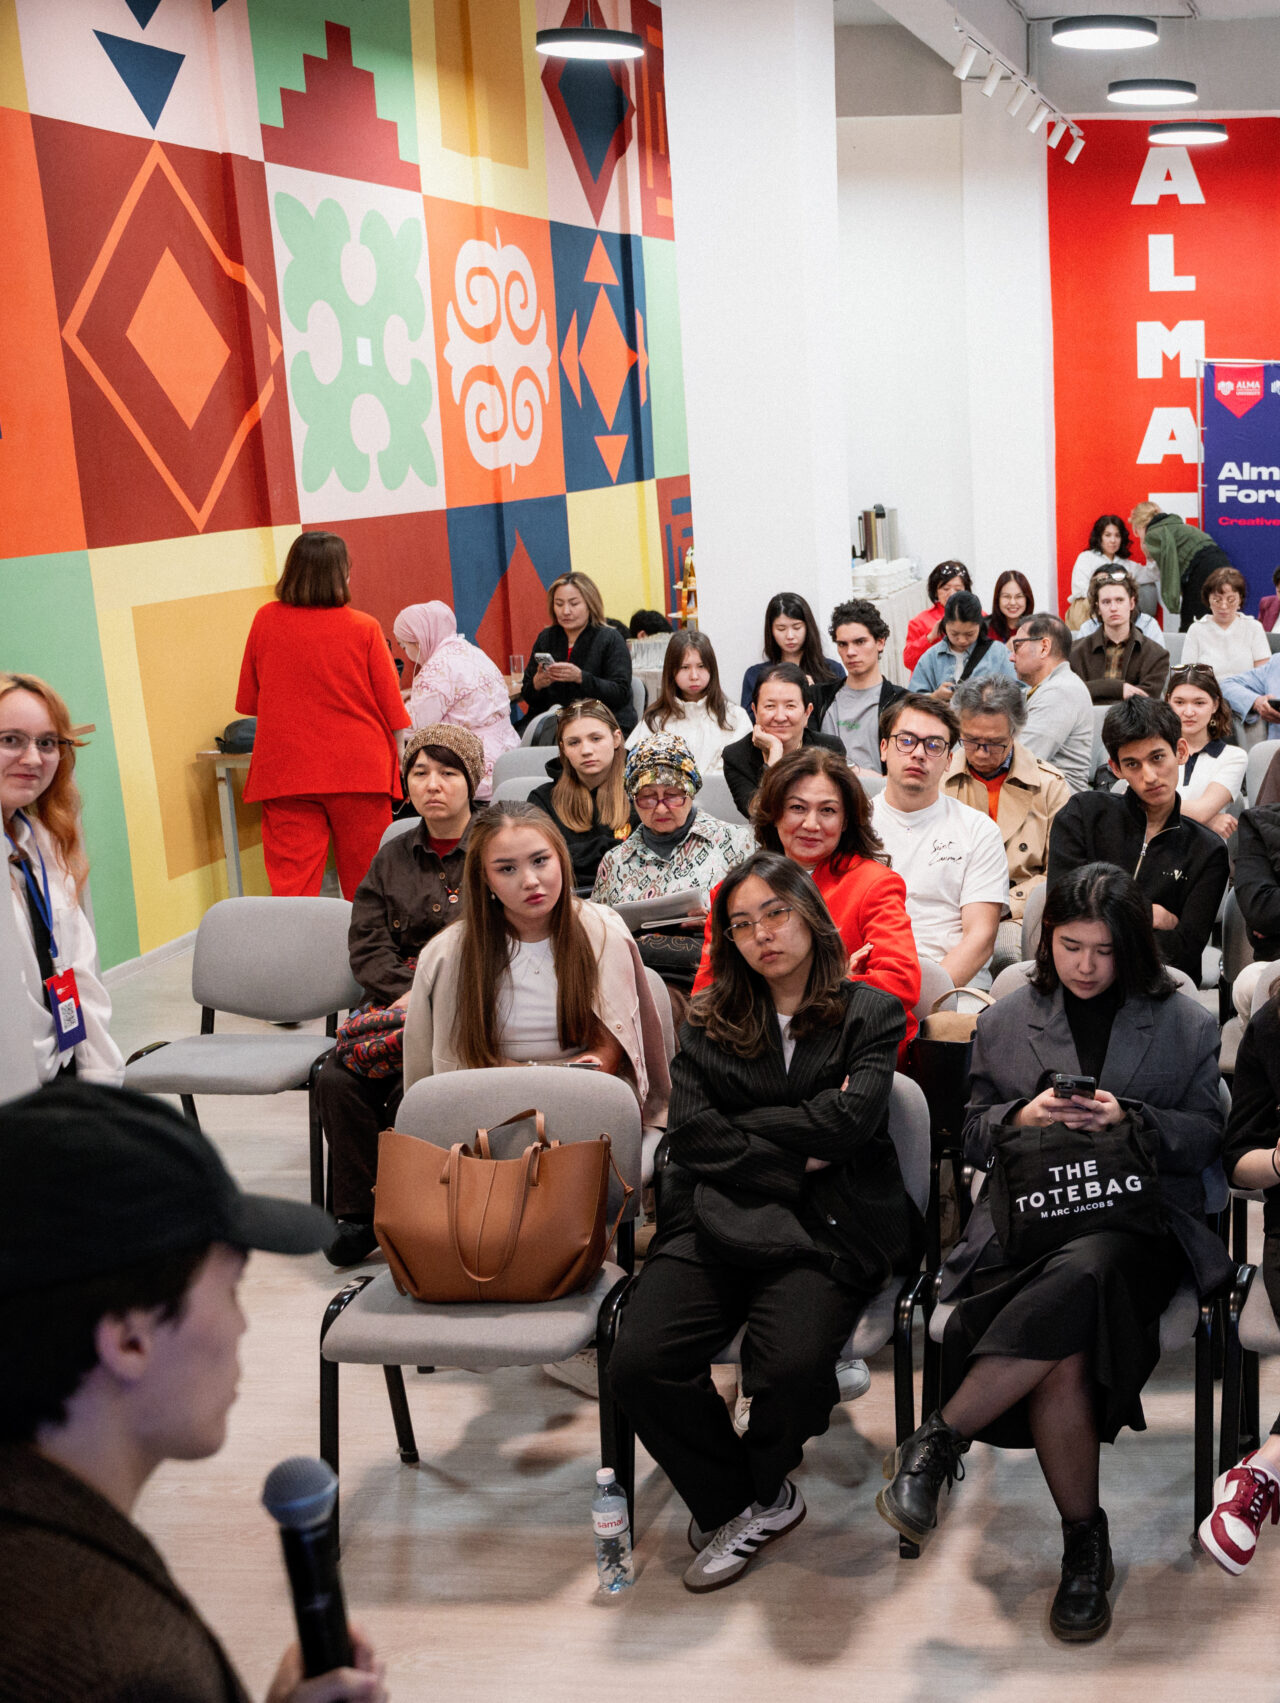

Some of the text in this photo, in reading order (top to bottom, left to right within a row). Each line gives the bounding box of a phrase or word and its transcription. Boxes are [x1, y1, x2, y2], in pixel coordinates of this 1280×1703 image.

[1236, 381, 1260, 389] ALMA
[1218, 516, 1280, 527] Creative
[1048, 1160, 1098, 1182] THE
[1040, 1200, 1114, 1218] MARC JACOBS
[597, 1516, 624, 1529] samal
